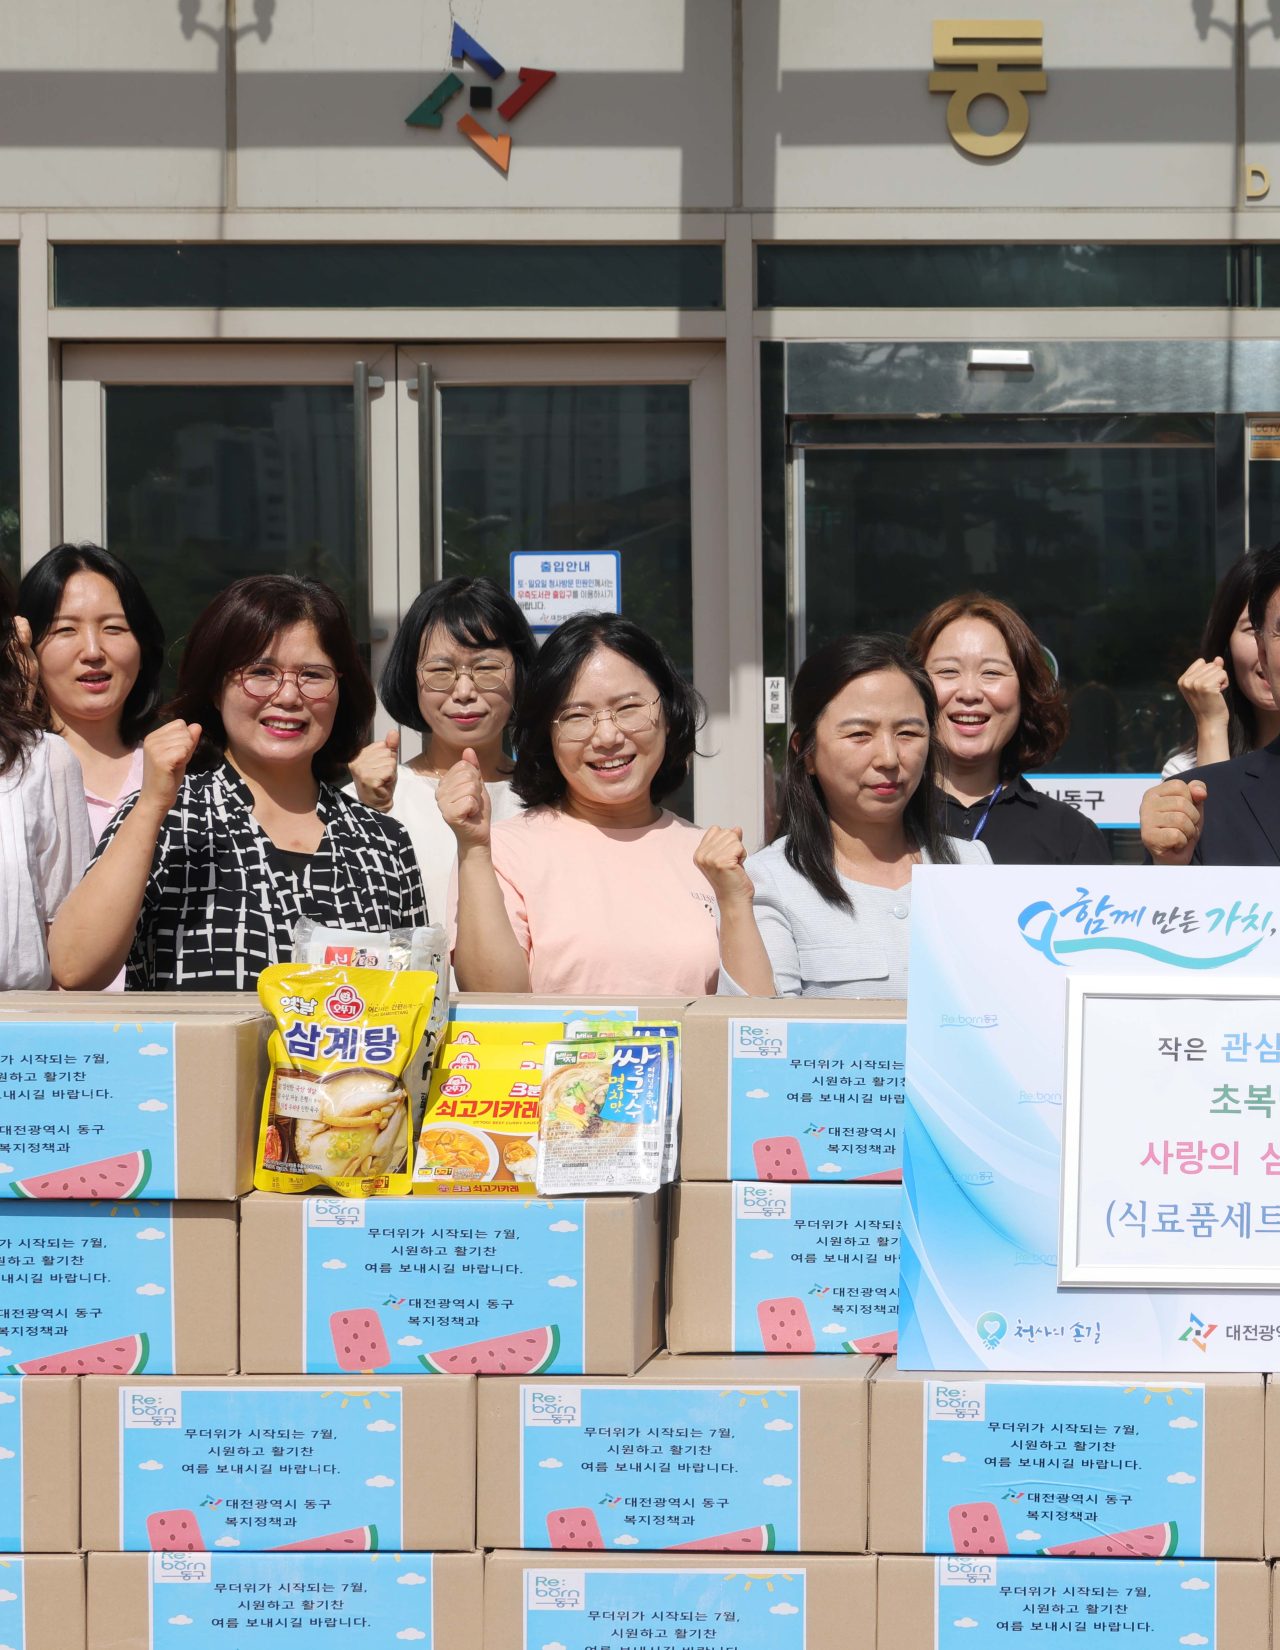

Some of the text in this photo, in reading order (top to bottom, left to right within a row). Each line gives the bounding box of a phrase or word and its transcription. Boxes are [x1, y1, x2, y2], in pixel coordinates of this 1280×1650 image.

[541, 561, 590, 572] 출입안내
[769, 680, 781, 715] 자동문
[1060, 887, 1147, 935] 함께
[1152, 906, 1200, 934] 만든
[1206, 900, 1277, 936] 가치,
[280, 996, 318, 1016] 옛날
[333, 1005, 357, 1015] 오뚜기
[285, 1022, 398, 1061] 삼계탕
[1158, 1037, 1208, 1061] 작은
[1220, 1032, 1280, 1064] 관심
[21, 1053, 109, 1065] 시작되는 7월,
[43, 1071, 86, 1082] 활기찬
[610, 1047, 660, 1118] 쌀국수
[52, 1088, 113, 1100] 바랍니다.
[510, 1082, 541, 1097] 3분
[608, 1073, 625, 1113] 멸치맛
[436, 1100, 540, 1118] 쇠고기카레
[0, 1124, 105, 1135] 대전광역시 동구
[0, 1142, 70, 1153] 복지정책과
[1140, 1140, 1239, 1175] 사랑의
[473, 1184, 519, 1192] 쇠고기카레
[368, 1229, 519, 1239] 무더위가 시작되는 7월,
[392, 1246, 496, 1256] 시원하고 활기찬
[365, 1263, 522, 1274] 여름 보내시길 바랍니다.
[409, 1299, 514, 1309] 대전광역시 동구
[408, 1316, 479, 1326] 복지정책과
[988, 1422, 1139, 1435] 무더위가 시작되는 7월,
[1011, 1440, 1116, 1452] 시원하고 활기찬
[985, 1457, 1141, 1470] 여름 보내시길 바랍니다.
[1028, 1493, 1132, 1505] 대전광역시 동구
[1027, 1511, 1098, 1522] 복지정책과
